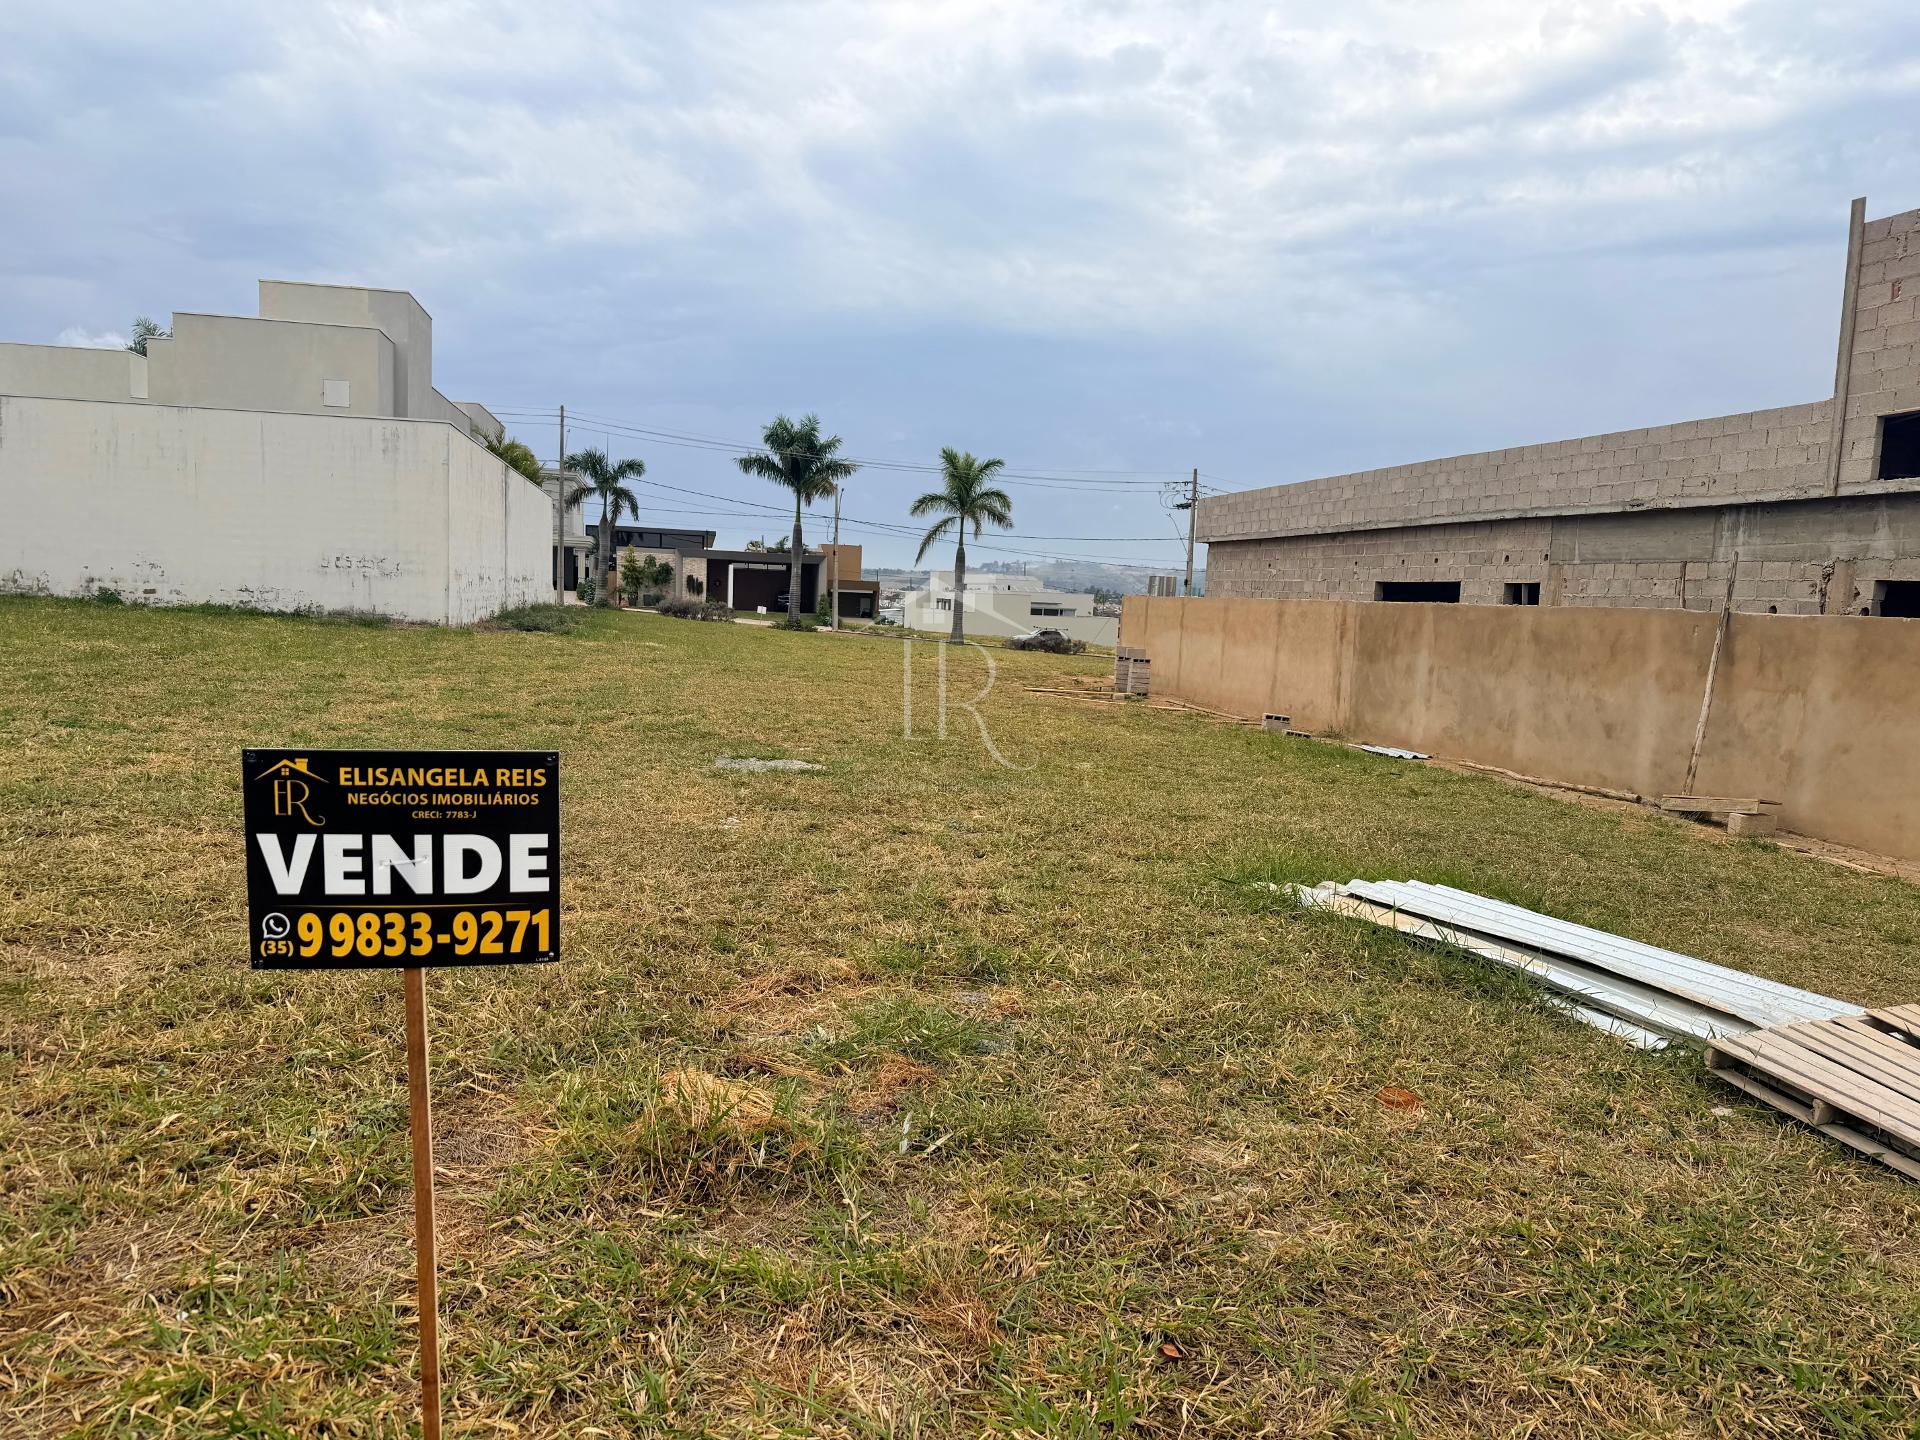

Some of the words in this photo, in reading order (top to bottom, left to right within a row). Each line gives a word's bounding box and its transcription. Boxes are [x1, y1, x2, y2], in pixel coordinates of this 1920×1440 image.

[339, 767, 490, 787] ELISANGELA
[496, 768, 547, 787] REIS
[347, 790, 429, 806] NEGÓCIOS
[432, 790, 539, 806] IMOBILIÁRIOS
[412, 810, 443, 819] CRECI:
[446, 810, 477, 819] 7783-J
[256, 833, 550, 895] VENDE
[260, 940, 294, 958] (35)
